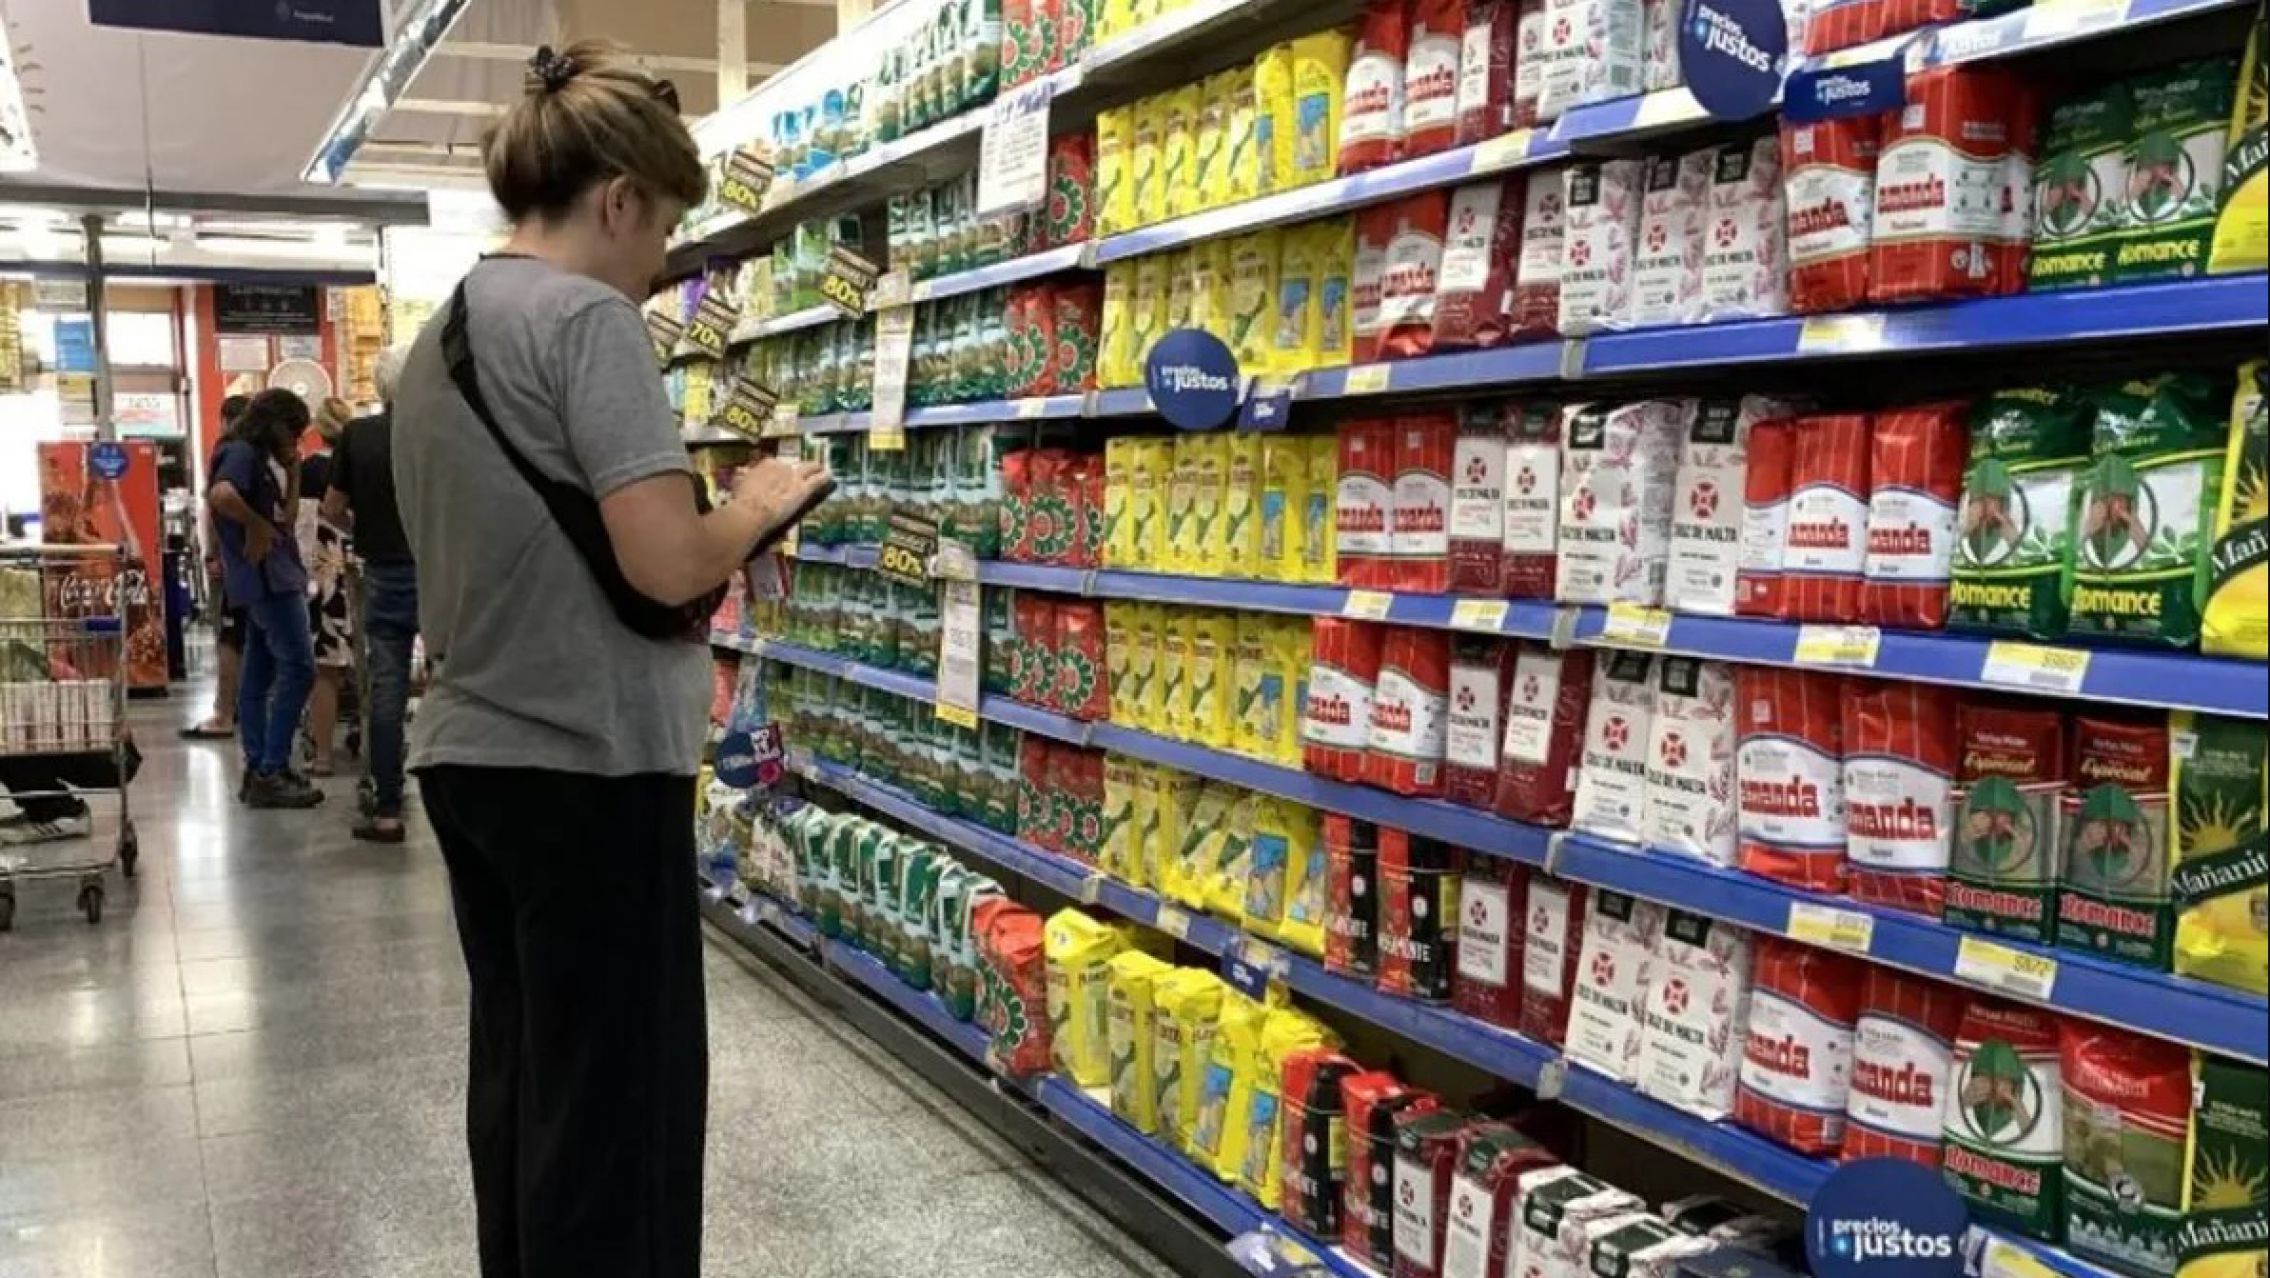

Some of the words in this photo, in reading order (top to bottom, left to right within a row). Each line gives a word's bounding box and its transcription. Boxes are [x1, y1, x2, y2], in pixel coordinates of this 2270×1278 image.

[1704, 25, 1771, 72] justos
[824, 274, 862, 309] 80%
[1173, 371, 1229, 393] justos
[883, 546, 923, 575] 80%
[1832, 1216, 1901, 1237] precios
[1854, 1228, 1953, 1263] justos
